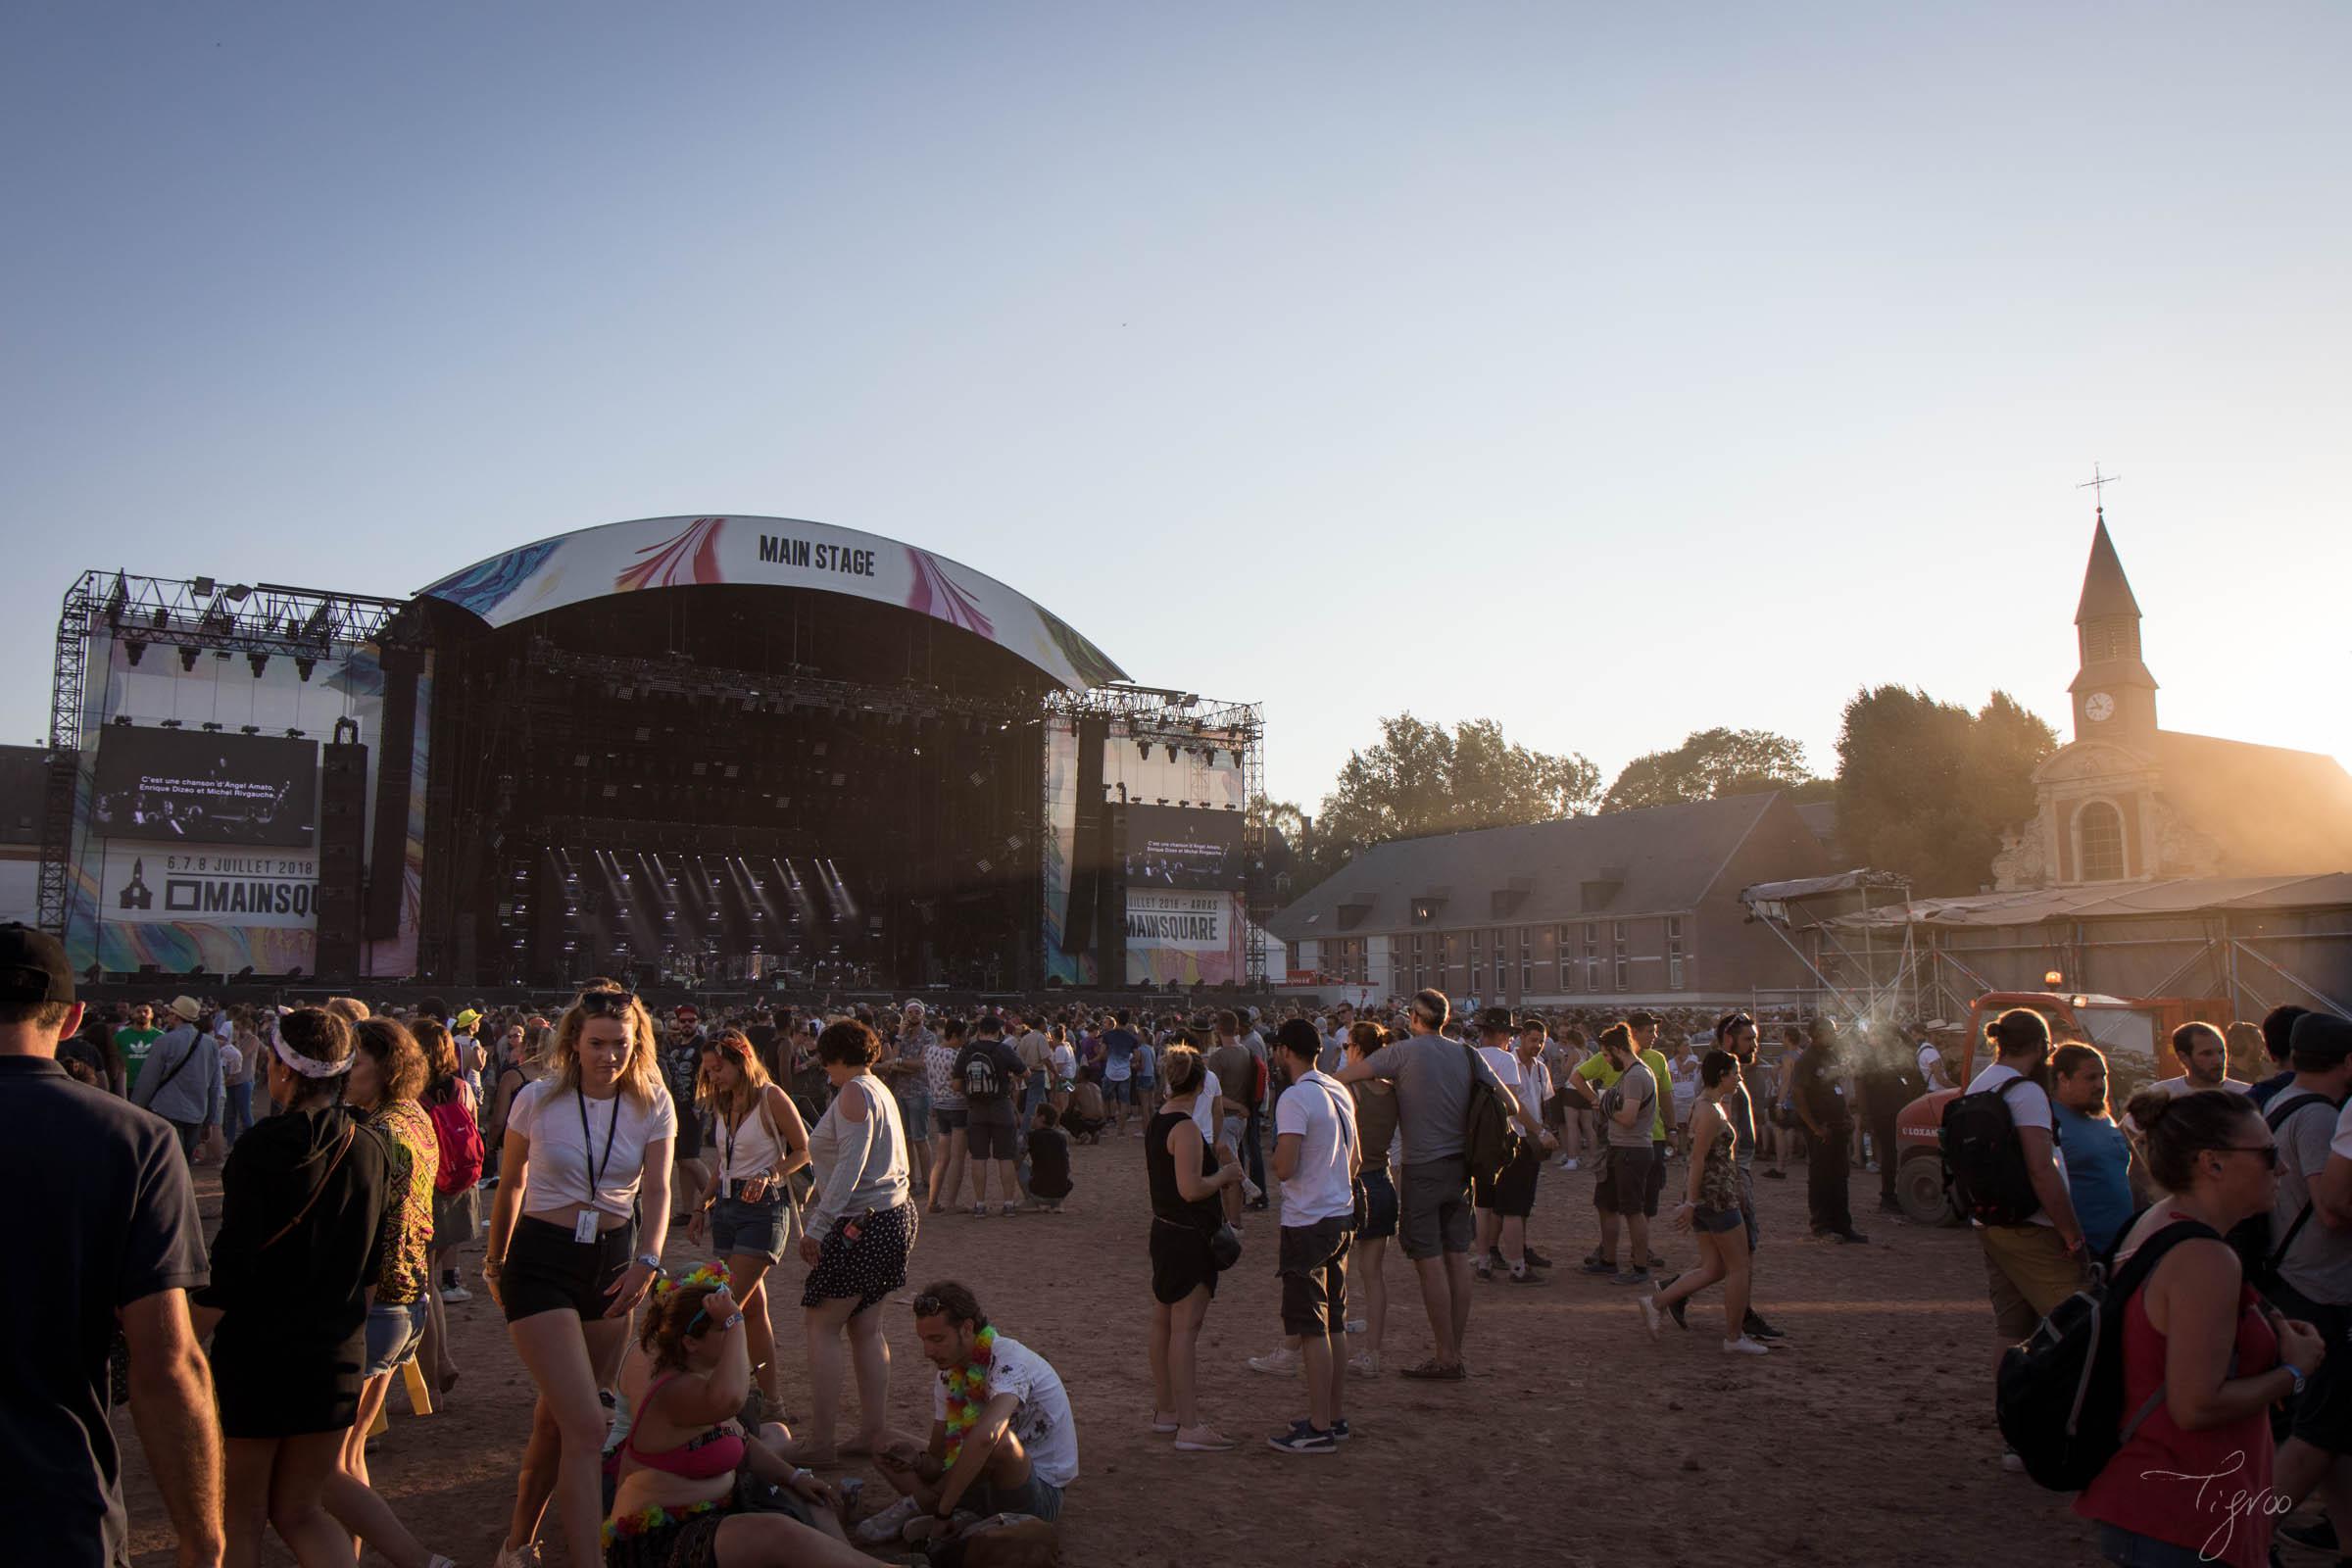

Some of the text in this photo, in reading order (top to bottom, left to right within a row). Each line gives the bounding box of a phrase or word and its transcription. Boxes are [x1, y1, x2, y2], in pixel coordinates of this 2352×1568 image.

[760, 534, 875, 577] MAIN STAGE
[141, 775, 163, 784] C'est
[182, 778, 215, 787] chanson
[139, 784, 170, 793] Enrique
[214, 858, 270, 873] JUILLET
[278, 861, 313, 875] 2018
[1128, 896, 1154, 908] UILLET
